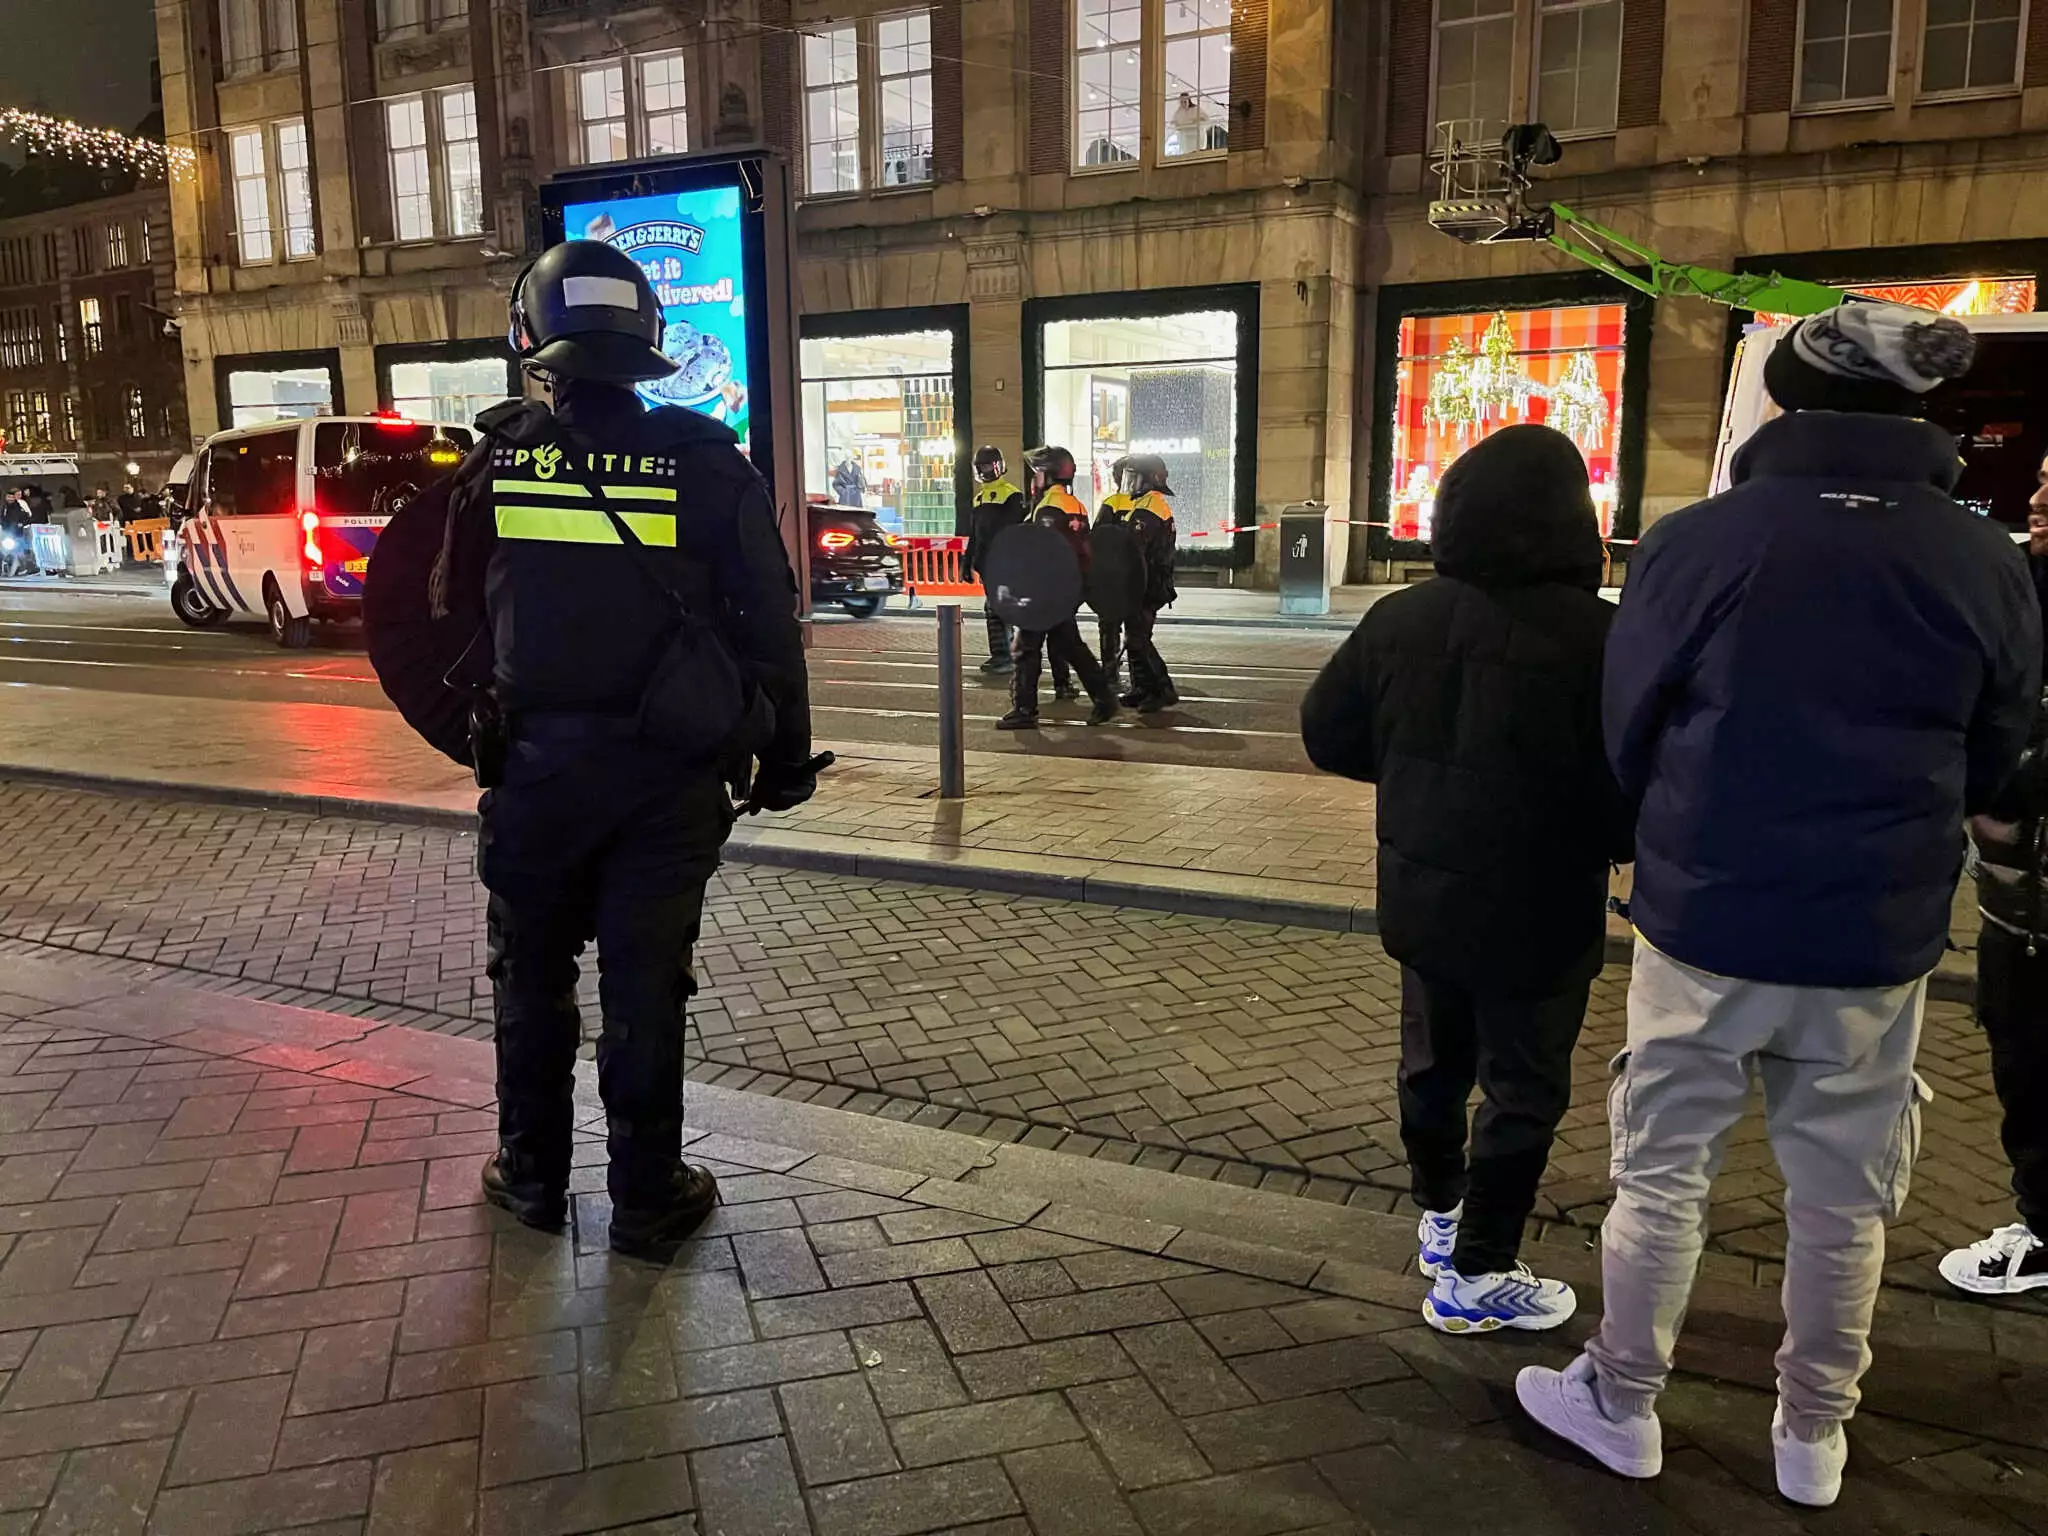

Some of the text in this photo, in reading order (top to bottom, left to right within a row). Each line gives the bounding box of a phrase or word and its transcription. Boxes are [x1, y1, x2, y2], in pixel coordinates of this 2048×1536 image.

[636, 257, 682, 281] et it
[656, 279, 732, 305] livered!
[515, 444, 655, 478] POITIE
